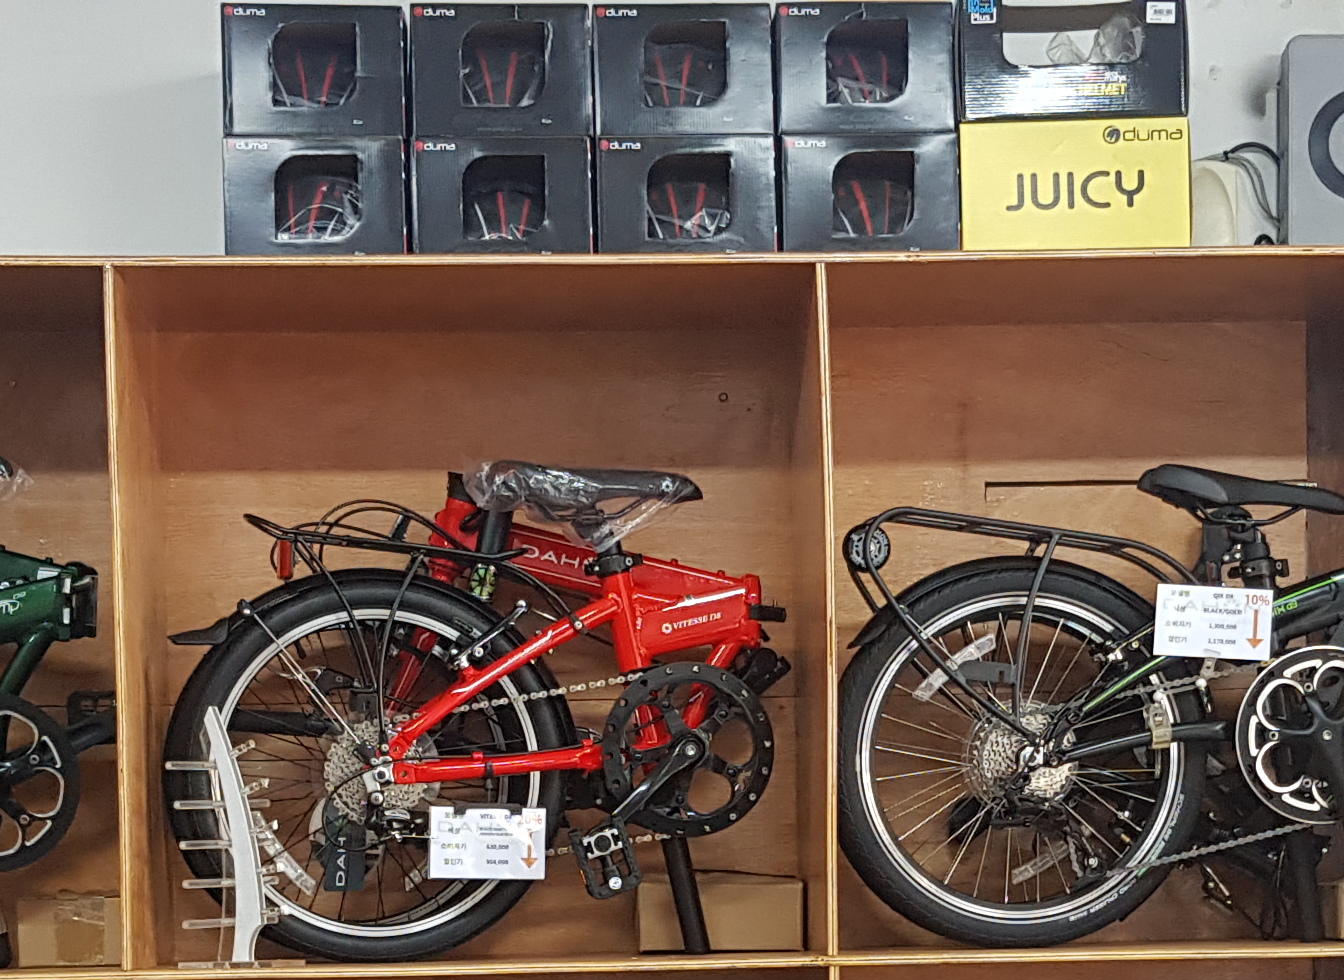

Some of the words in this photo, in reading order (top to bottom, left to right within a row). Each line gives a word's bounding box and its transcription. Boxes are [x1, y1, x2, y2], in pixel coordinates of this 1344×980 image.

[233, 6, 267, 17] duma
[423, 6, 456, 17] duma
[604, 6, 638, 17] duma
[788, 6, 820, 17] duma
[1122, 126, 1184, 143] duma
[235, 140, 268, 151] duma
[424, 140, 456, 151] duma
[608, 139, 641, 151] duma
[795, 138, 826, 149] duma
[1006, 170, 1145, 211] JUICY
[521, 545, 594, 571] DAH
[1245, 594, 1270, 606] 10%
[672, 616, 708, 631] VITESSE
